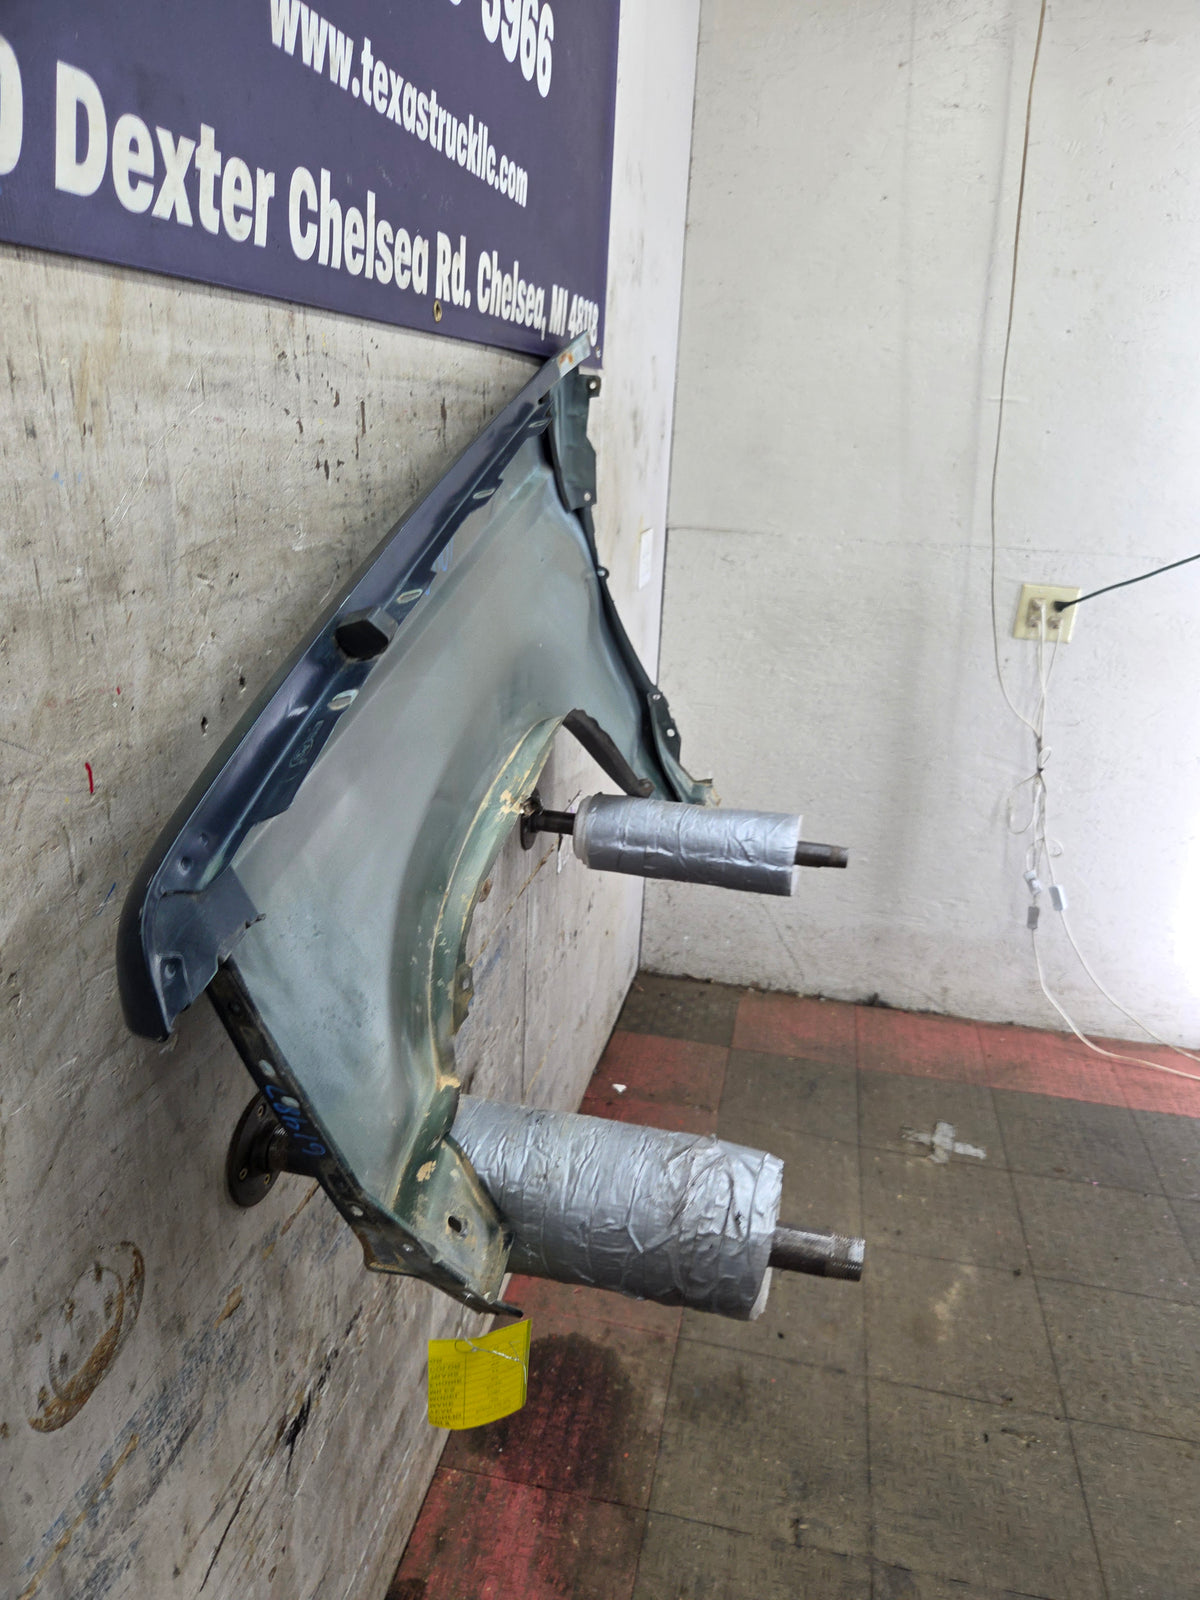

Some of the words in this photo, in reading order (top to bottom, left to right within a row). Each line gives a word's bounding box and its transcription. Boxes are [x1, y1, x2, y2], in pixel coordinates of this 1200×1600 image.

[55, 60, 276, 248] Dexter
[288, 166, 429, 296] Chelsea
[435, 230, 472, 309] Rd.
[477, 250, 547, 341] Chelsea,
[548, 284, 570, 337] MI
[568, 294, 600, 347] 48118
[270, 0, 529, 208] www.texastruckllc.com
